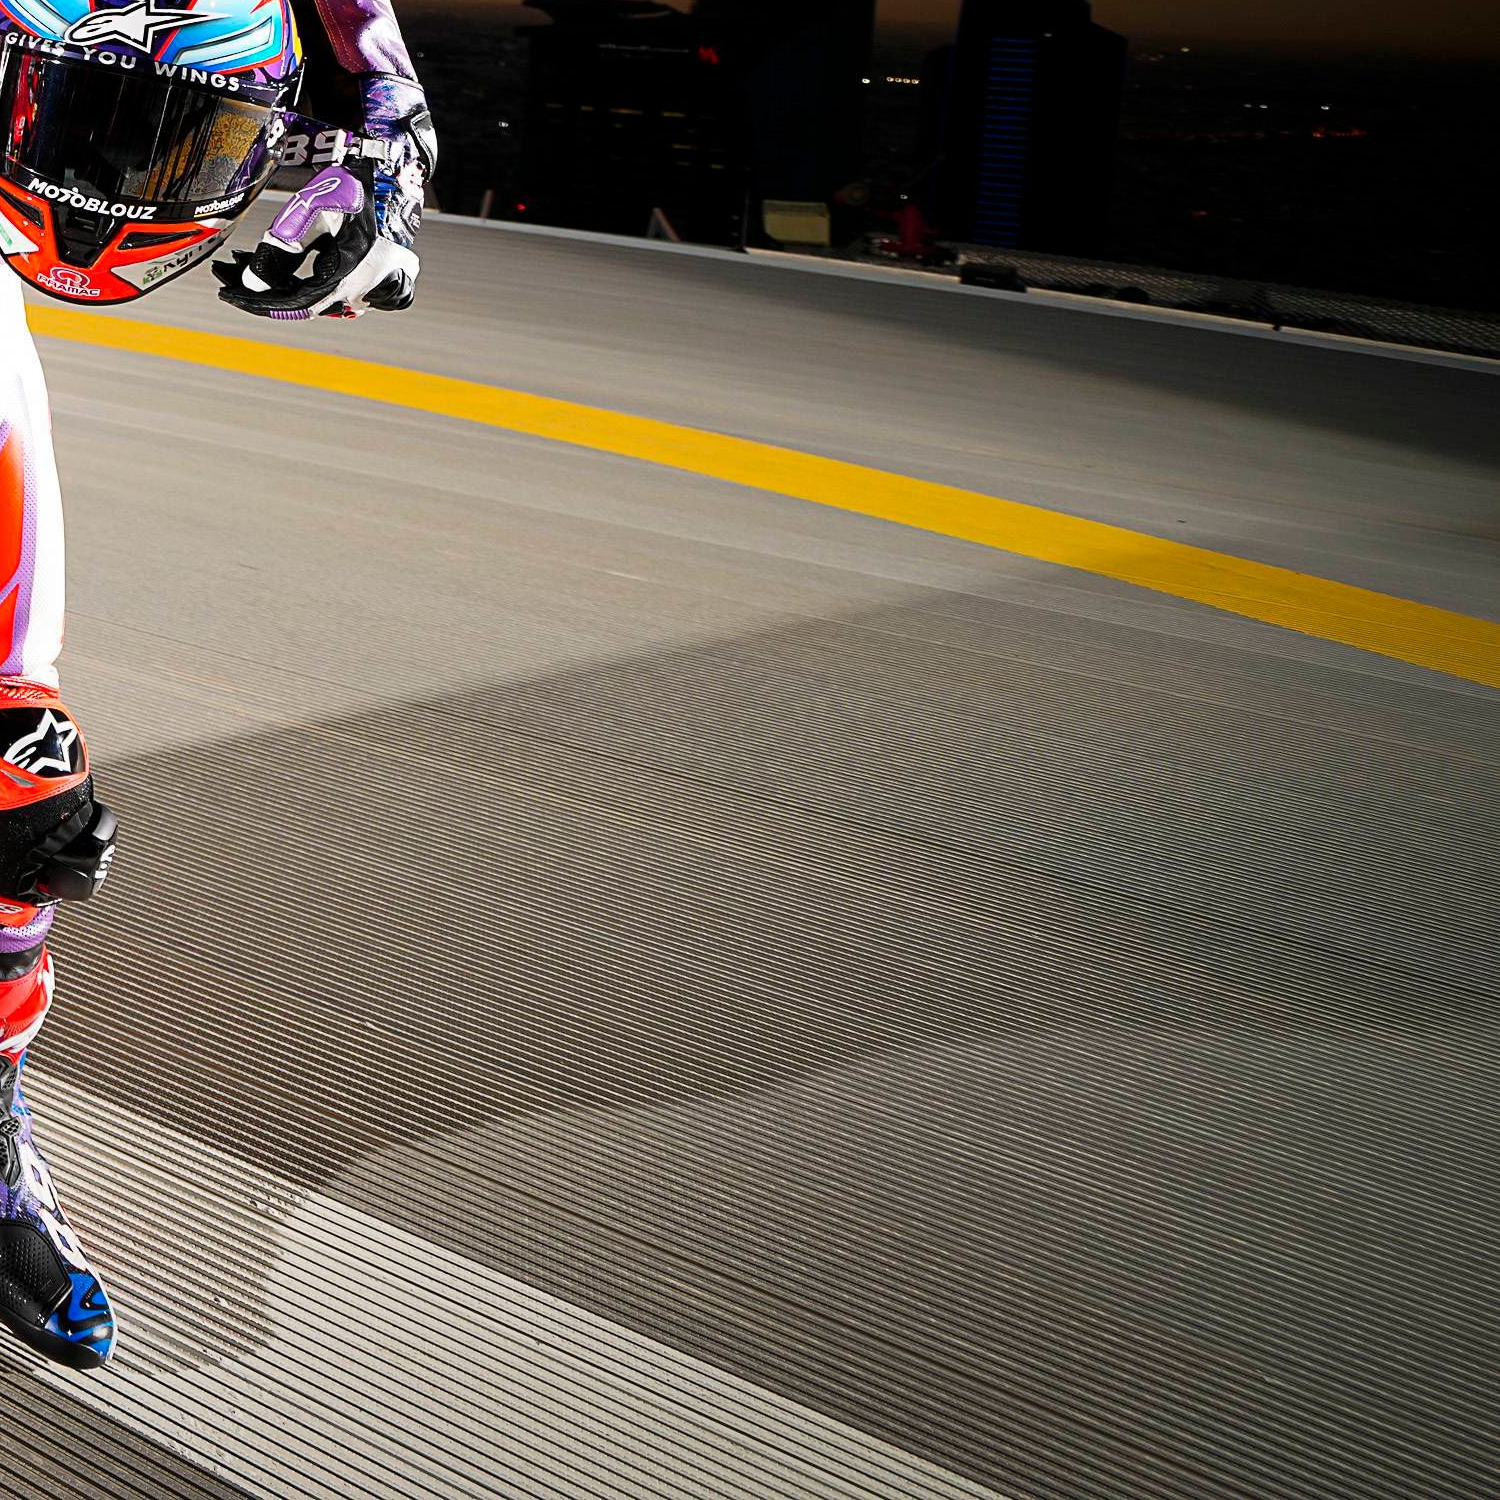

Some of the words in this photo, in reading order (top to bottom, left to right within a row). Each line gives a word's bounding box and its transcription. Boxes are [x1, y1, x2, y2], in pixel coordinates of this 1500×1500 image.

[5, 32, 68, 58] GIVES
[83, 47, 137, 70] YOU
[154, 61, 241, 92] WINGS
[281, 130, 343, 167] 89
[28, 177, 158, 220] MOTOBLOUZ
[194, 192, 246, 215] MOTOBLOUZ
[38, 274, 99, 296] PRAMAC
